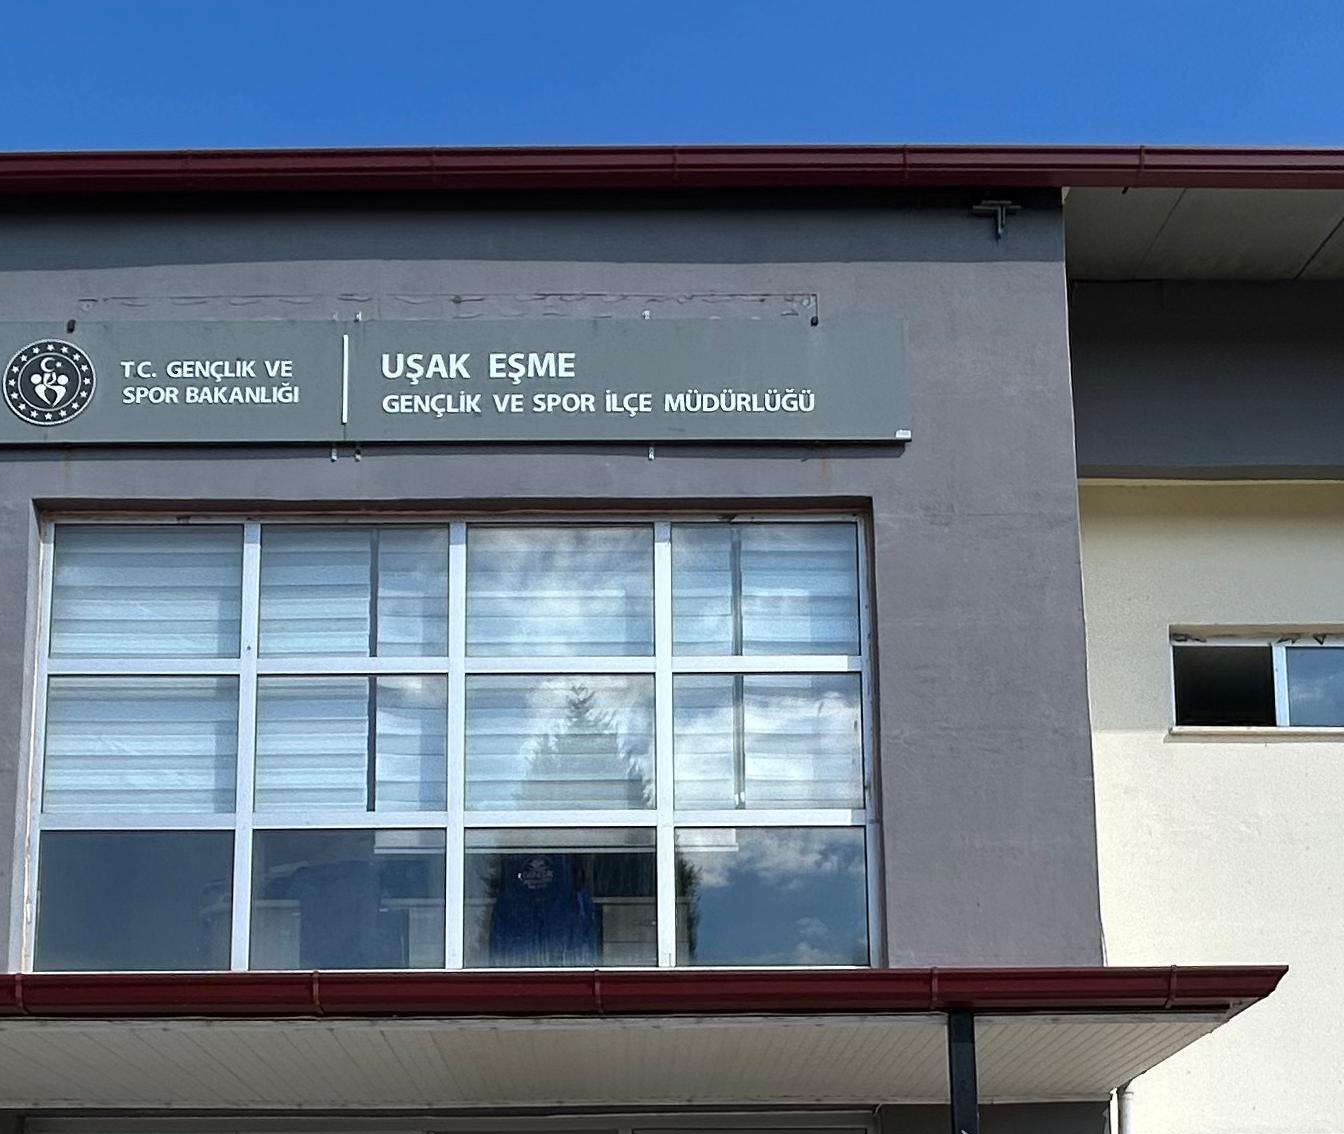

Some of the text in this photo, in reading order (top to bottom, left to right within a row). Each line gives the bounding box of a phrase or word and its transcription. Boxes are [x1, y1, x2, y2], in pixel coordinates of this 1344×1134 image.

[264, 360, 293, 378] VE
[380, 352, 577, 385] UŞAK EŞME
[122, 382, 300, 405] SPOR BAKANLIĞI
[381, 388, 816, 418] GENÇLİK VE SPOR İLÇE MÜDÜRLÜĞÜ
